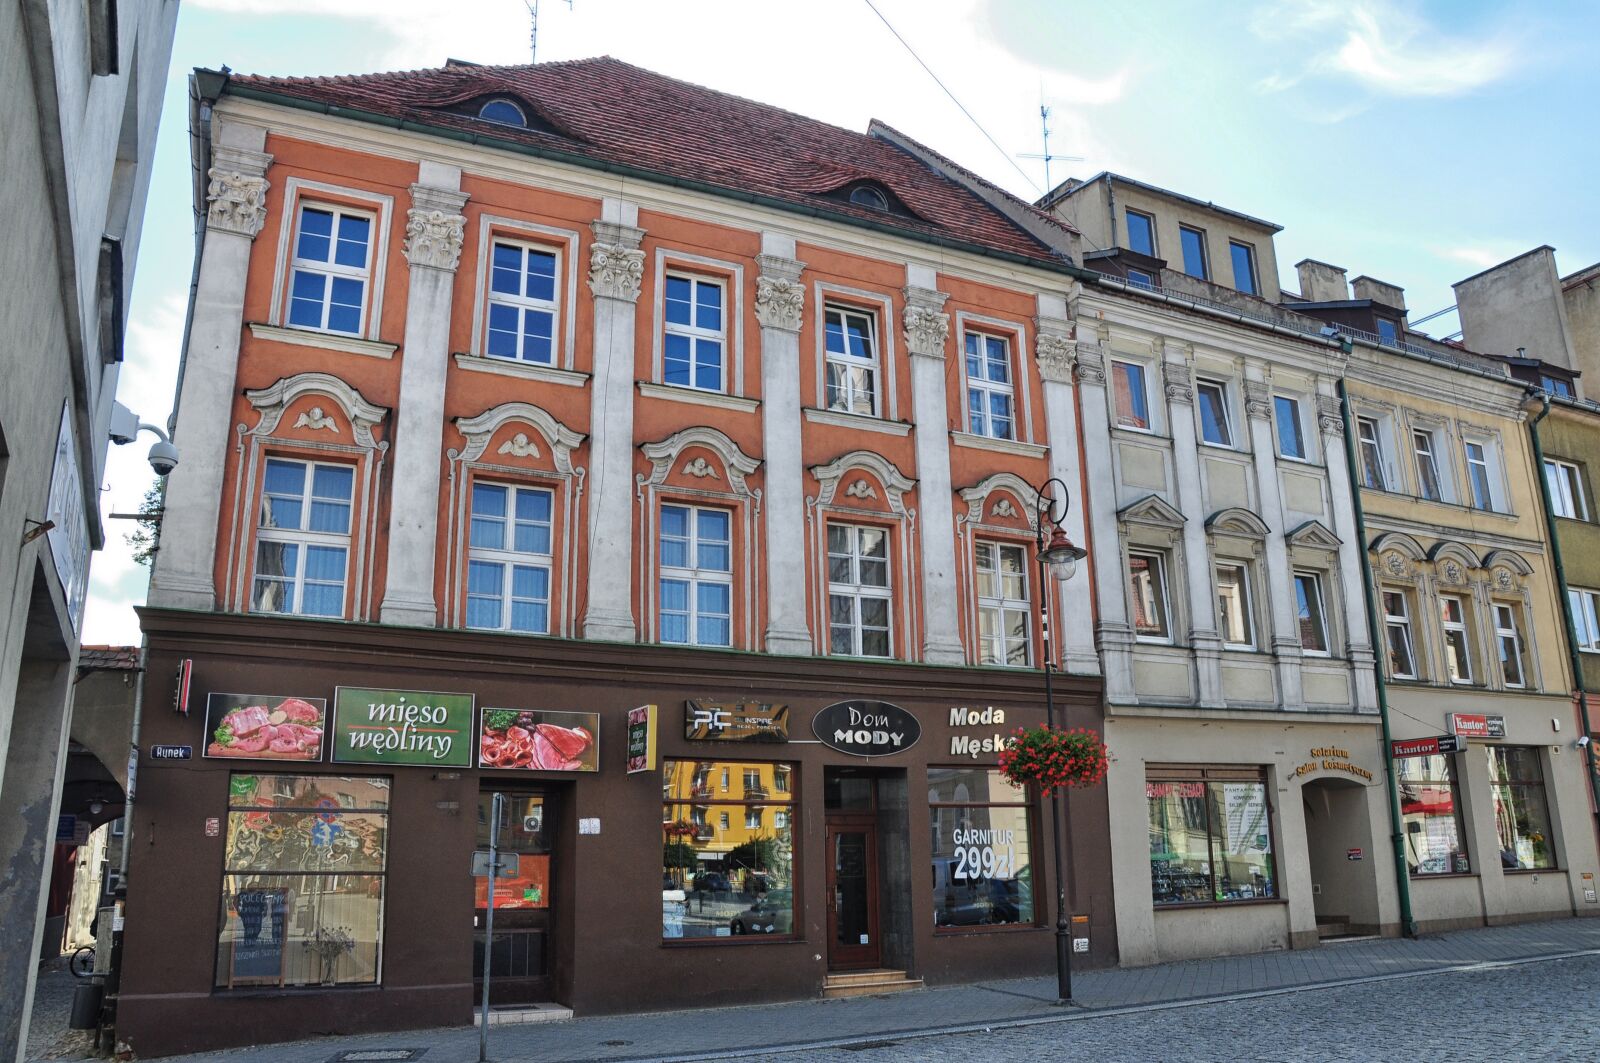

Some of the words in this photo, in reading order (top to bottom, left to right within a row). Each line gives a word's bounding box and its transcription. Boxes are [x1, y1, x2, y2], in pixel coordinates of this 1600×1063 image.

[368, 696, 448, 727] mięso
[849, 706, 889, 728] Dom
[950, 706, 1005, 727] Moda
[1455, 717, 1484, 730] Kantor
[349, 722, 452, 759] wędliny
[834, 728, 905, 746] MODY
[156, 747, 184, 758] Rynek
[1310, 747, 1349, 758] Solarium
[1394, 743, 1435, 755] Kantor
[1296, 761, 1318, 776] Salon
[1322, 759, 1373, 782] Kosmetyczny
[953, 828, 1014, 845] GARNITUR
[953, 846, 1015, 880] 299zł
